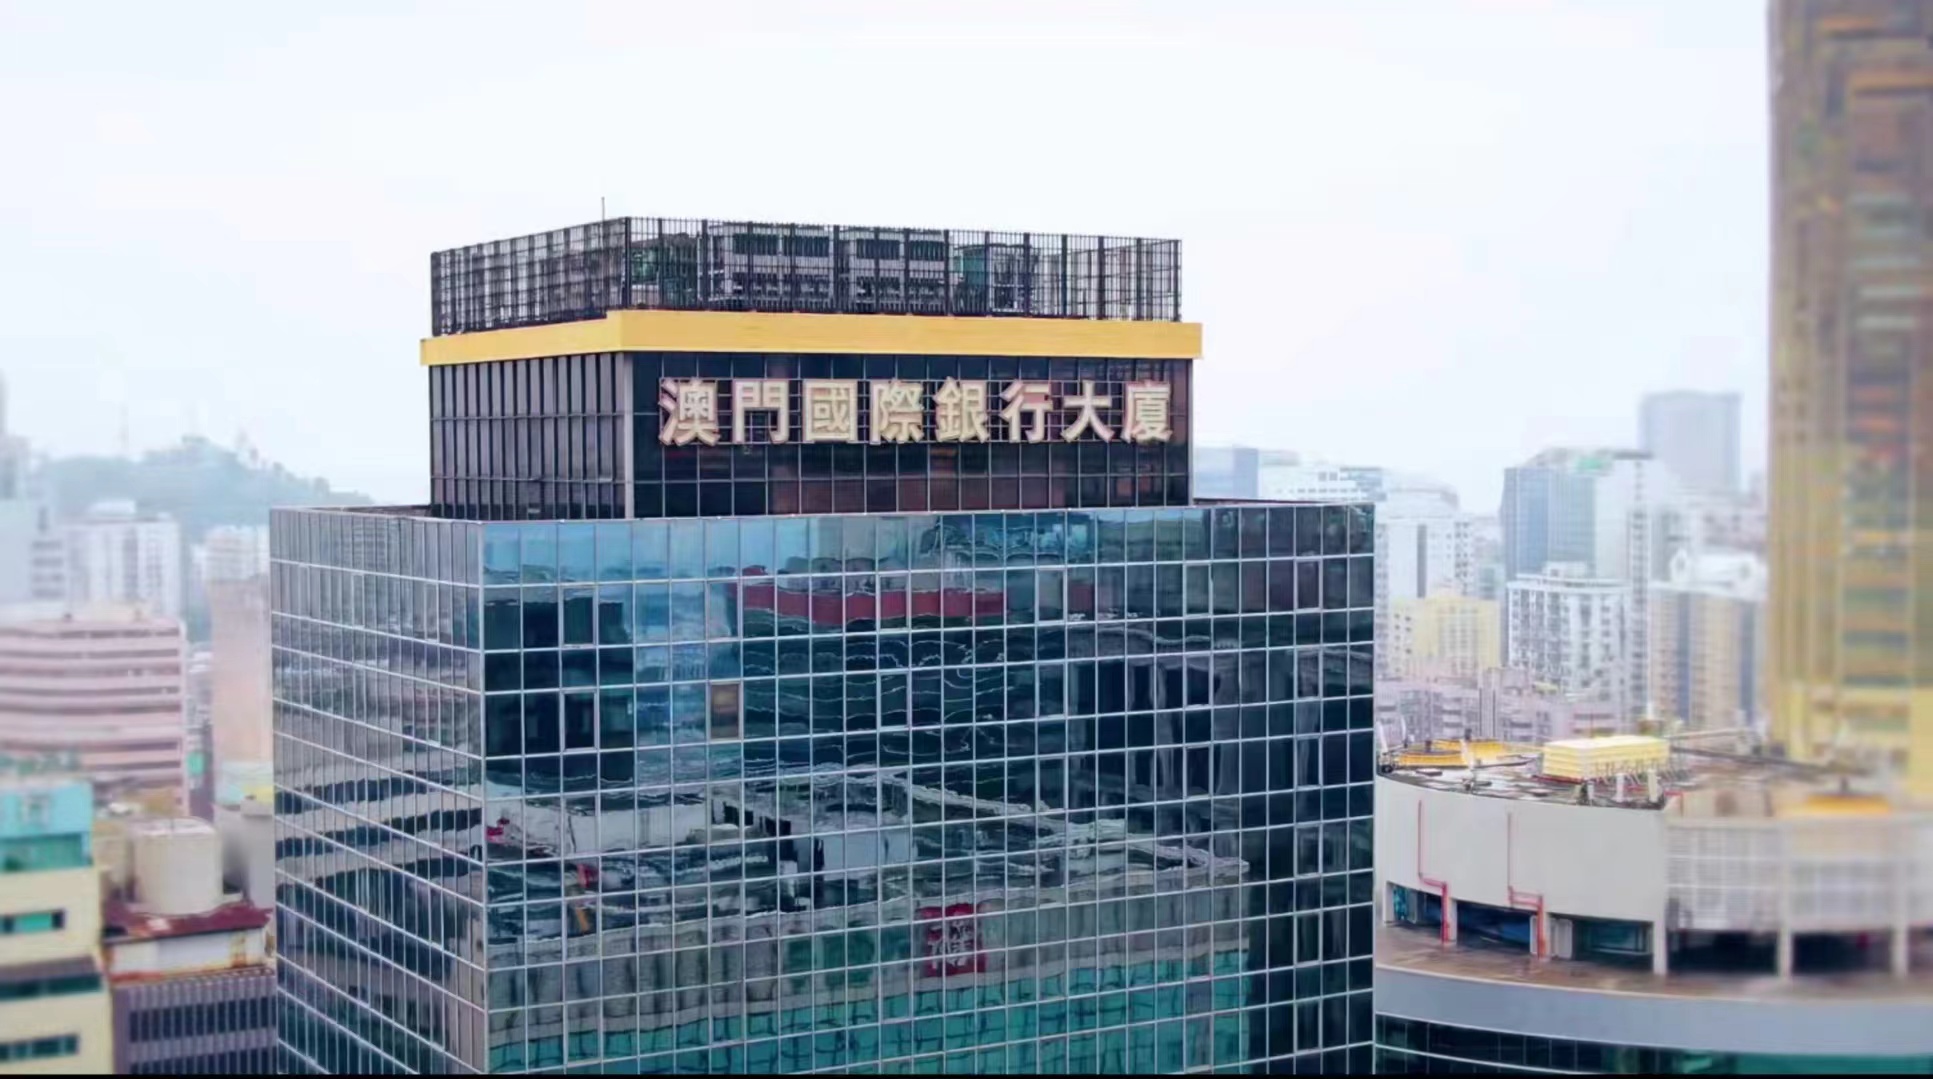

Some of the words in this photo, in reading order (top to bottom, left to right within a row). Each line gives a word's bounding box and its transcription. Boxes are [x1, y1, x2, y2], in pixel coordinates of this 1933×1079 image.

[658, 377, 1174, 445] 澳門國際銀行大廈
